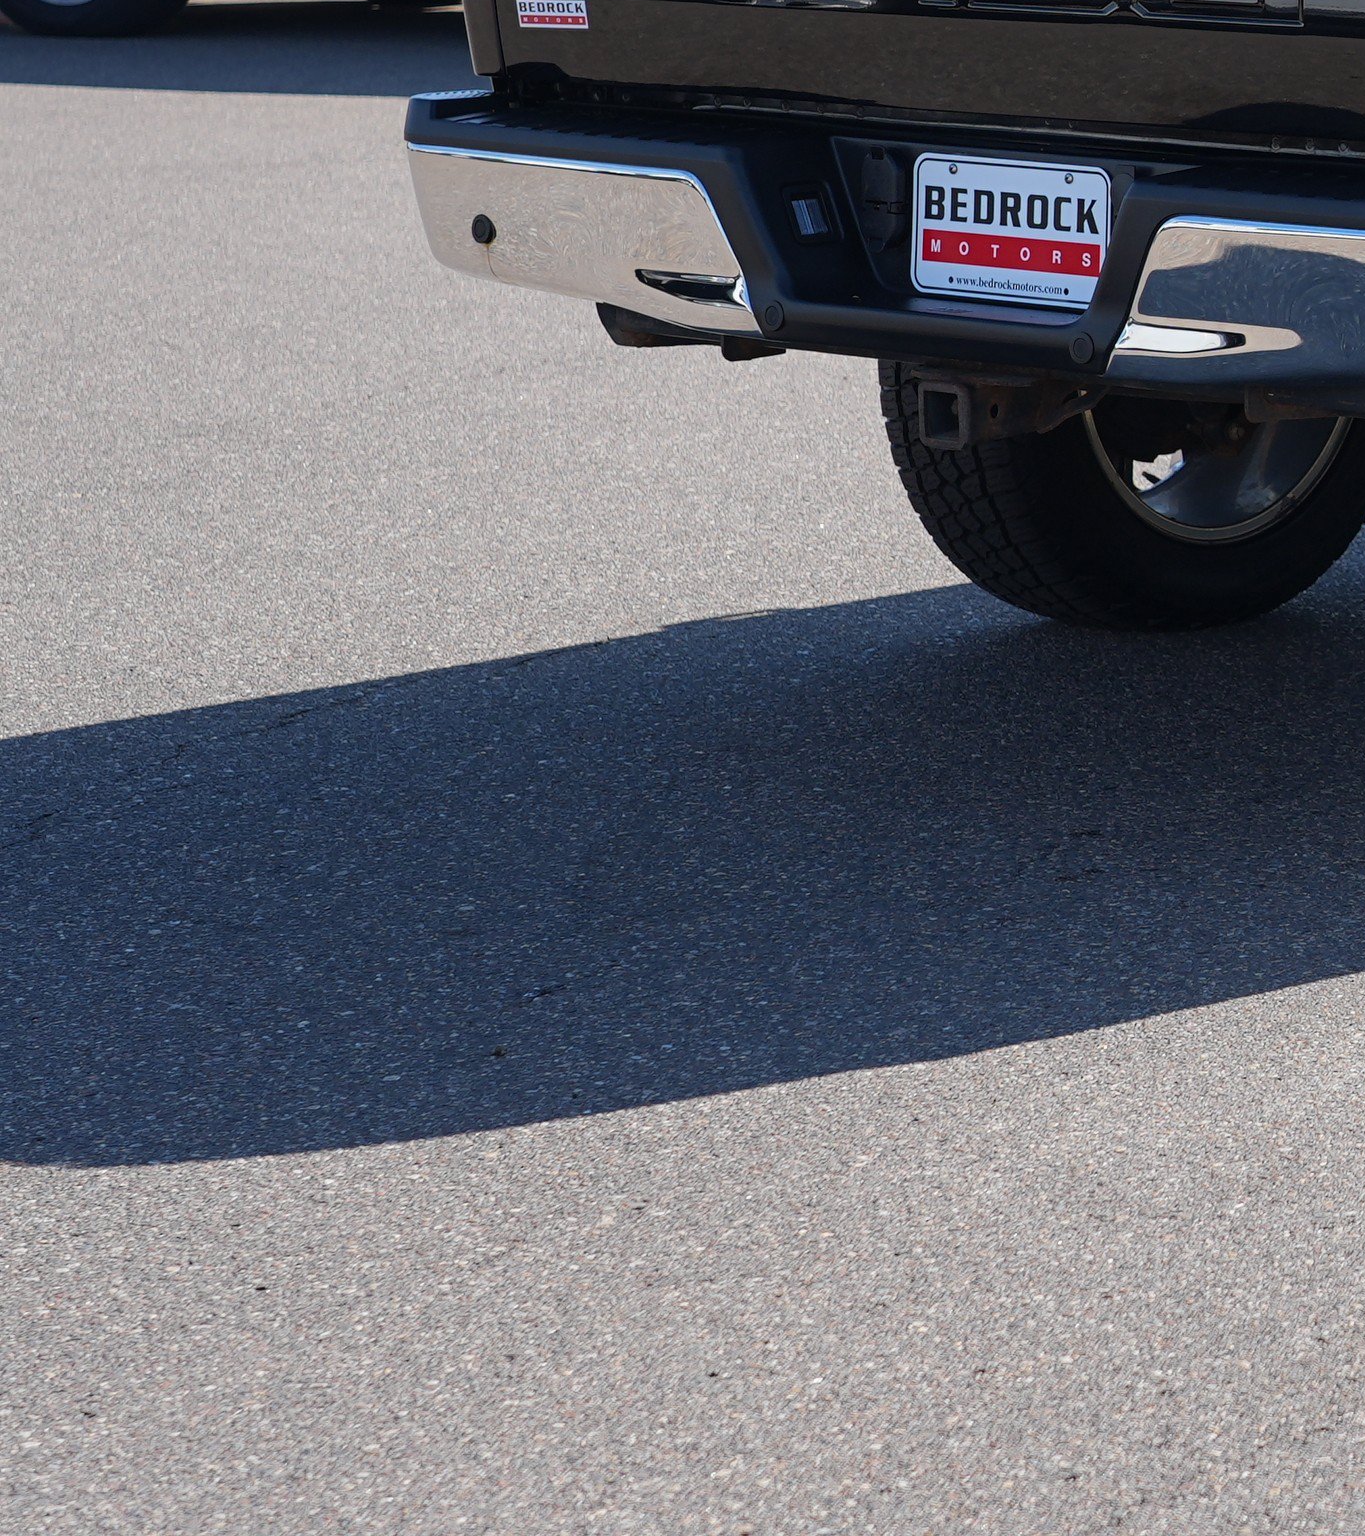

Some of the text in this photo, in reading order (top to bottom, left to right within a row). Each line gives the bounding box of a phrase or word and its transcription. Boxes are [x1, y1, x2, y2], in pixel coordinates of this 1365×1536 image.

[519, 1, 585, 14] BEDROCK
[924, 185, 1100, 235] BEDROCK
[930, 238, 1092, 268] MOTORS
[955, 276, 1063, 296] www.bedrockmotors.com
